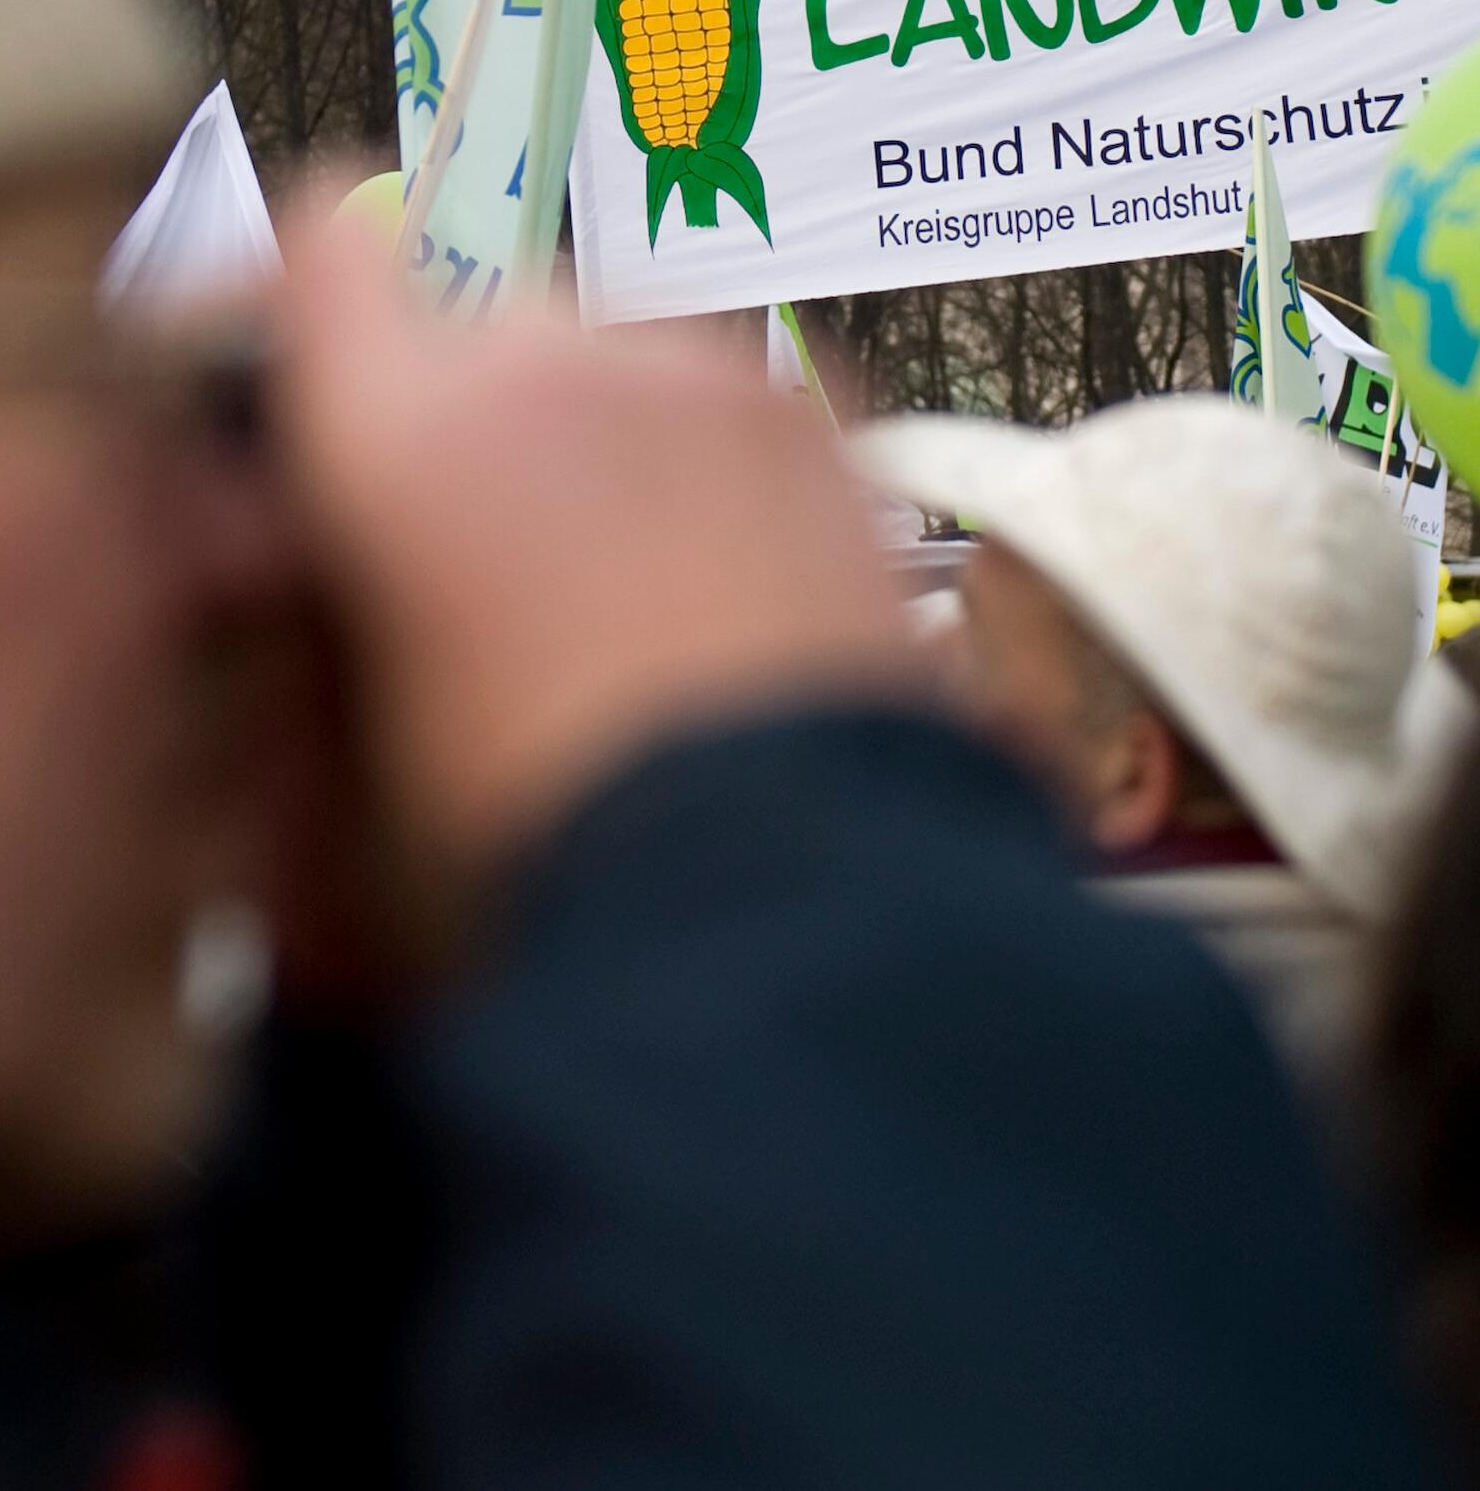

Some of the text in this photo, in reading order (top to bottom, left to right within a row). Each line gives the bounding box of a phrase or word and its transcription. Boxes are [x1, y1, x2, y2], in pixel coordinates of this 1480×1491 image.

[874, 125, 1024, 189] Bund
[1051, 87, 1409, 170] Naturschutz
[878, 180, 1243, 249] Kreisgruppe Landshut
